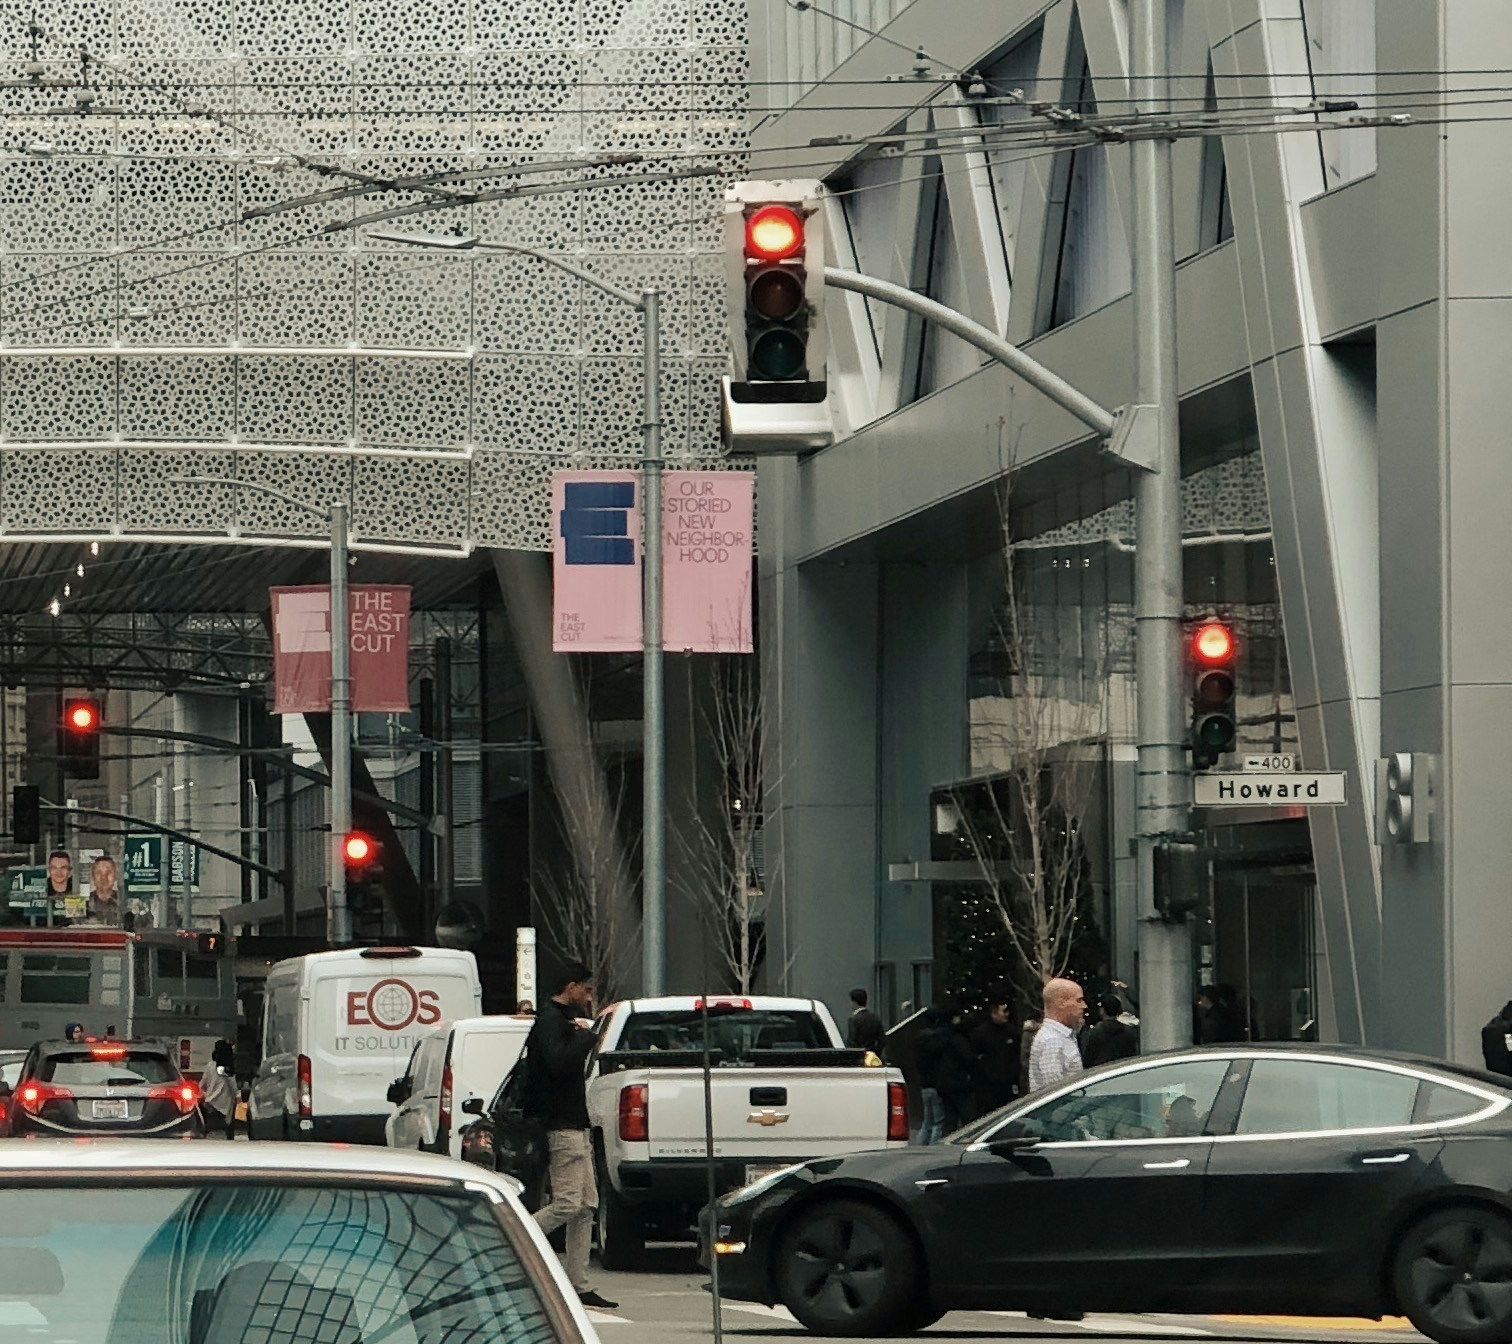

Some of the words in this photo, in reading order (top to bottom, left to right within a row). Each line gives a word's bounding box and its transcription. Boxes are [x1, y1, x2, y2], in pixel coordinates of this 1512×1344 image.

[680, 481, 715, 496] OUR
[668, 498, 732, 513] STORIED
[679, 515, 716, 529] NEW
[668, 531, 748, 546] NEIGHBOR-
[680, 548, 729, 563] HOOD
[351, 592, 392, 611] THE
[351, 613, 405, 632] EAST
[561, 613, 581, 622] THE
[560, 623, 585, 632] EAST
[350, 634, 395, 653] CUT
[561, 632, 581, 642] CUT
[1262, 757, 1291, 769] 400
[1219, 780, 1319, 798] Howard
[171, 841, 184, 883] BABSON
[209, 937, 216, 950] 7
[347, 978, 442, 1031] EOS
[335, 1037, 349, 1050] IT
[355, 1036, 420, 1050] SOLUTI
